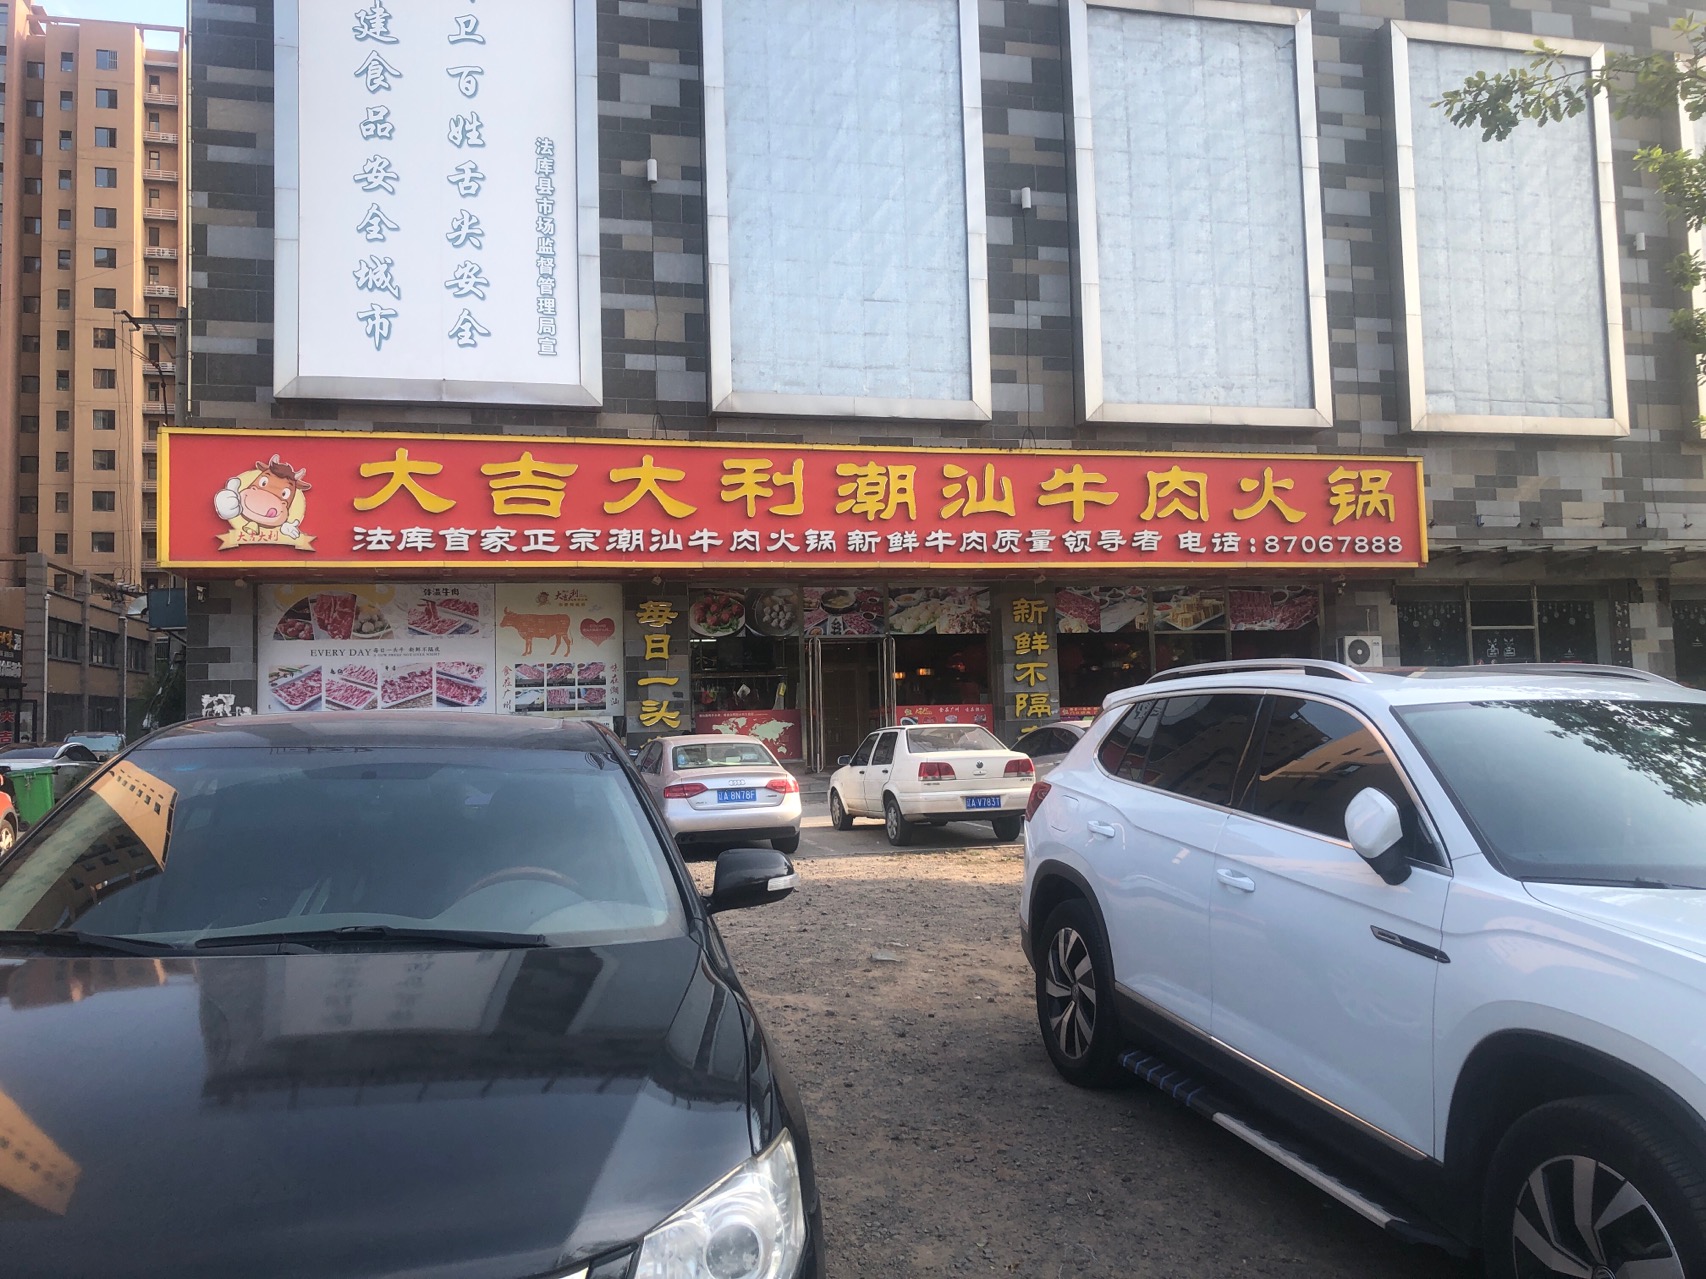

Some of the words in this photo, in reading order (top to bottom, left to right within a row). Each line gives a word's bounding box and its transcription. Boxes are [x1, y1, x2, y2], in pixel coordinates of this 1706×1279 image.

[445, 0, 491, 348] 卫百姓舌尖安全
[535, 136, 557, 357] 法库县市场监督管理局宣
[352, 446, 1396, 524] 大吉大利潮汕牛肉火锅
[310, 648, 346, 657] EVERY
[349, 648, 372, 657] DAY
[636, 600, 681, 749] 每日一头
[1012, 597, 1051, 741] 新鲜不隔
